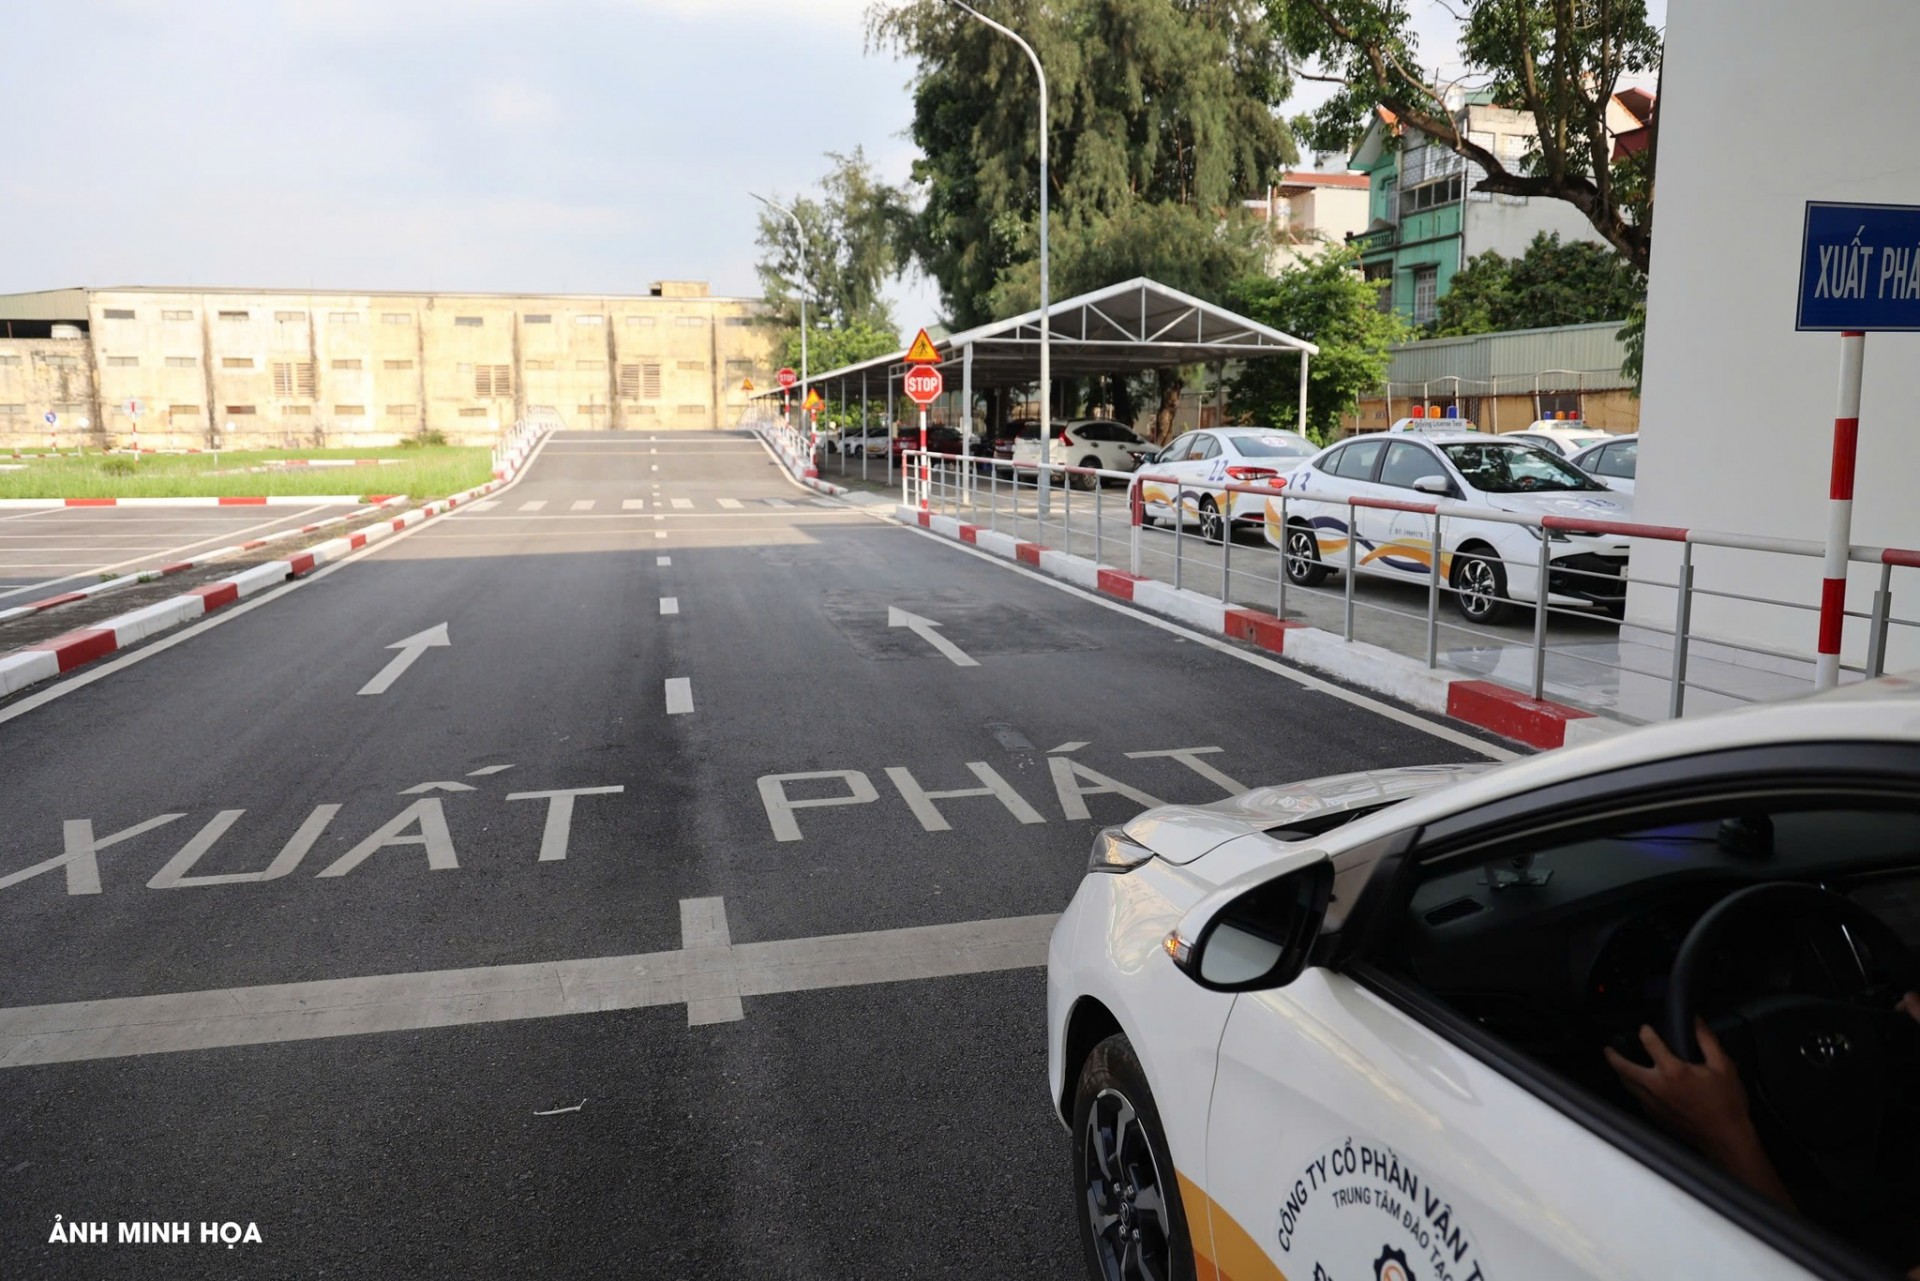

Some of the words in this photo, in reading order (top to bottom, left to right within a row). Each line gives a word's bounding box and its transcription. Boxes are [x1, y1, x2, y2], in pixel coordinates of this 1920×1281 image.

[1814, 225, 1874, 299] XUẤT
[779, 373, 794, 382] STOP
[908, 376, 938, 393] STOP
[1208, 460, 1229, 481] 22
[0, 764, 624, 896] XUẤT
[756, 741, 1250, 842] PHÁT
[1278, 1180, 1308, 1252] CÔNG
[1305, 1155, 1327, 1191] TY
[1332, 1136, 1356, 1176] CỔ
[1360, 1146, 1418, 1202] PHẦN
[1424, 1186, 1469, 1263] VẬN
[1332, 1187, 1371, 1209] TRUNG
[1374, 1189, 1401, 1220] TÂM
[1402, 1210, 1430, 1249] ĐÀO
